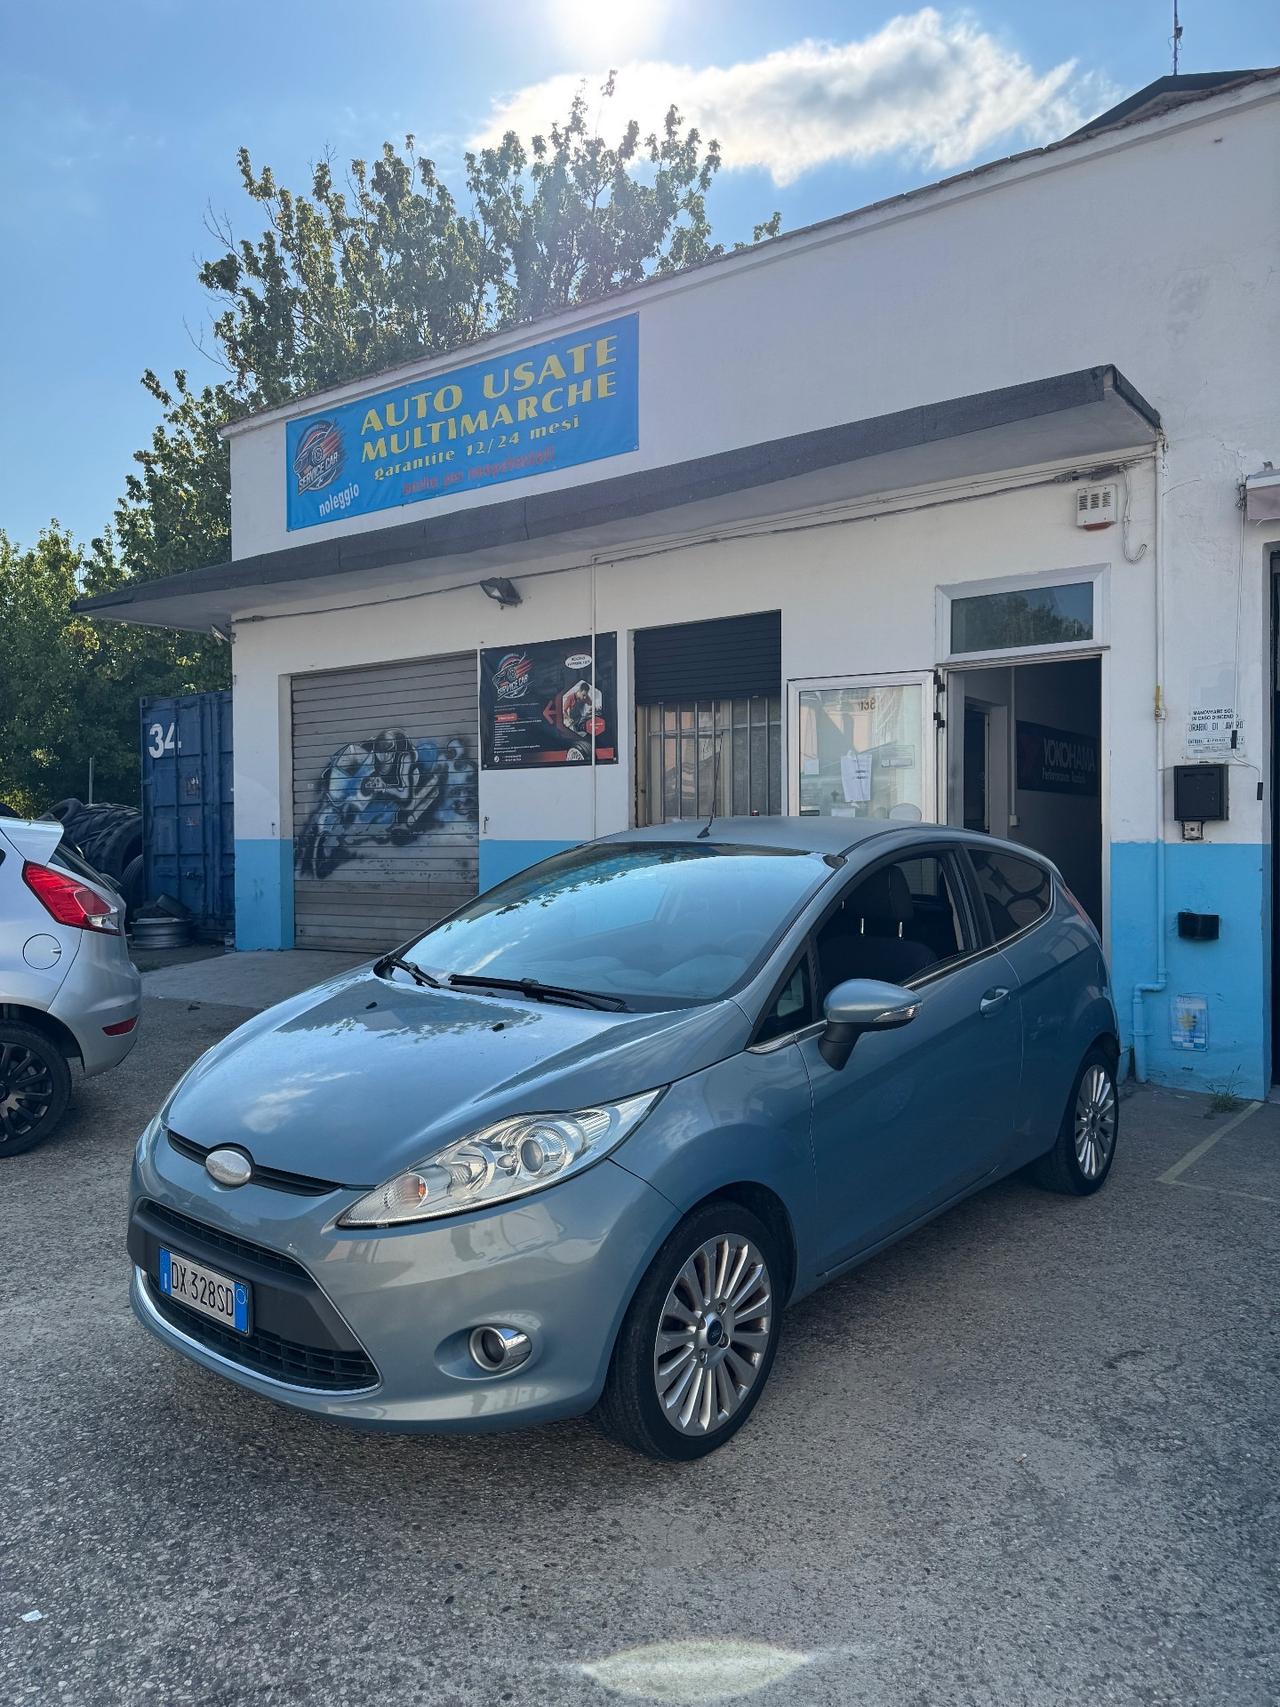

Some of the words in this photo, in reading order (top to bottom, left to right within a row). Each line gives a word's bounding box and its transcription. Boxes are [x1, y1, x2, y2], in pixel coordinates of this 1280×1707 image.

[360, 385, 463, 435] AUTO
[483, 335, 618, 399] USATE
[360, 371, 617, 463] MULTIMARCHE
[374, 448, 455, 480] garantite
[466, 431, 520, 457] 12/24
[530, 415, 580, 440] mesi
[319, 483, 359, 516] noleggio
[148, 722, 182, 758] 34
